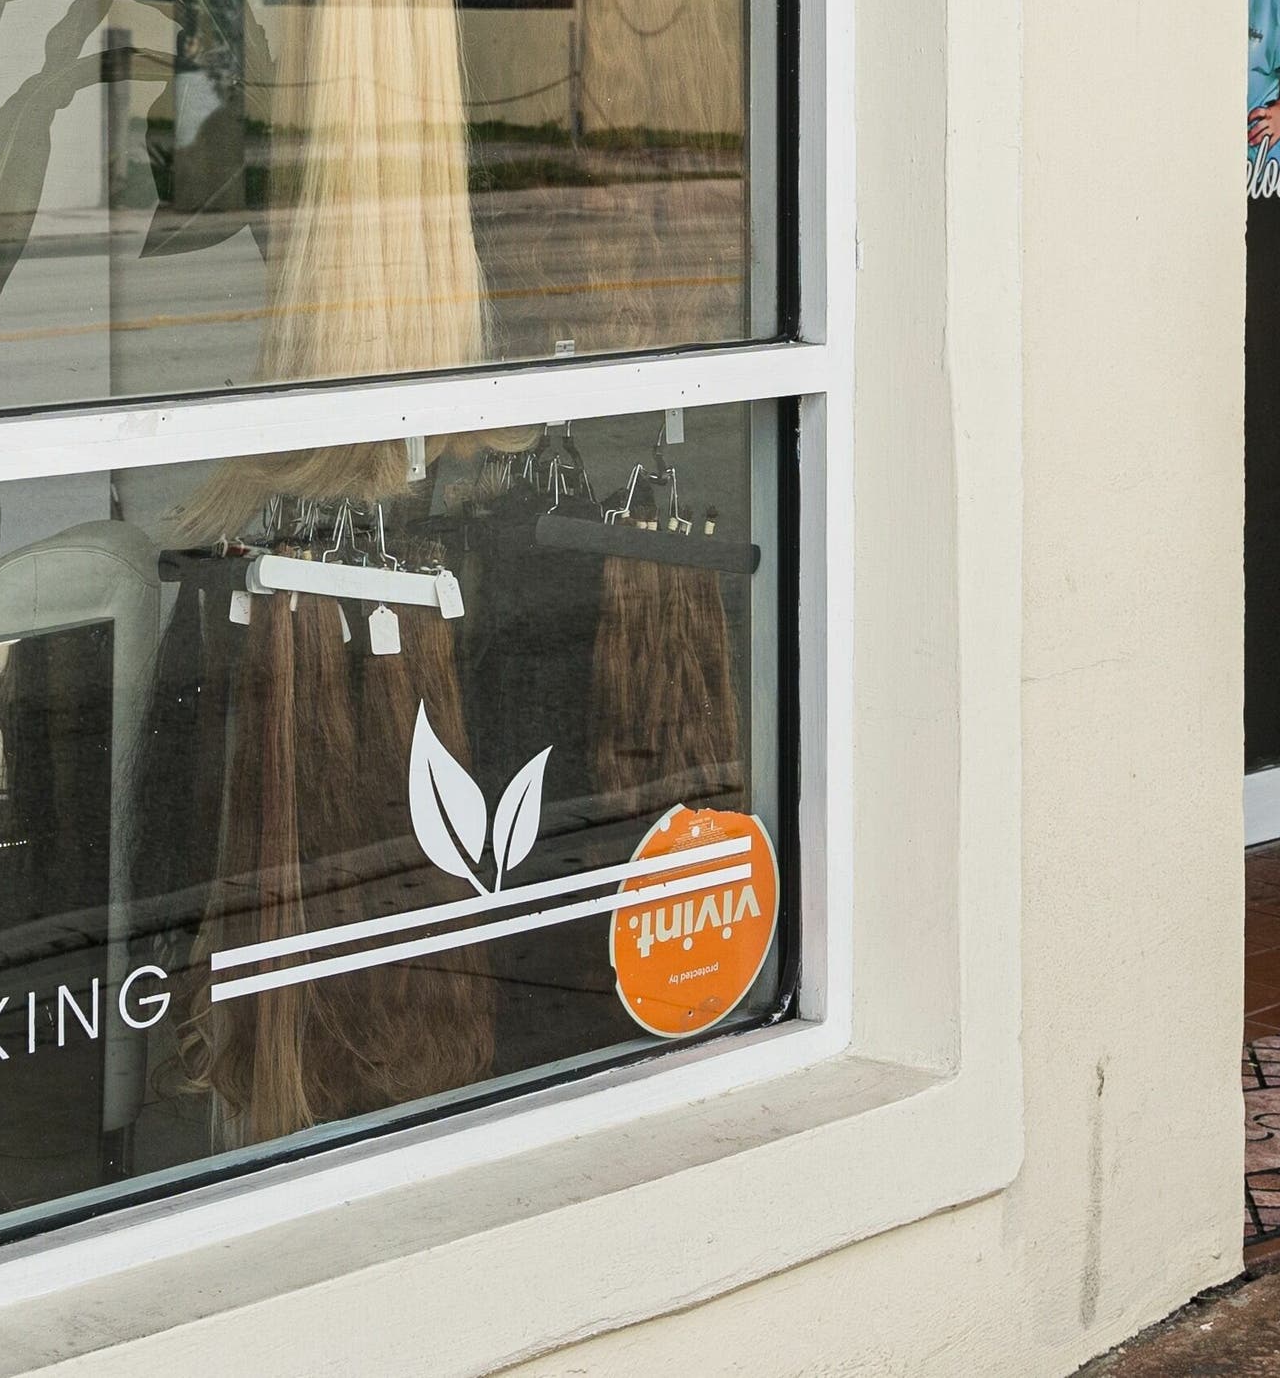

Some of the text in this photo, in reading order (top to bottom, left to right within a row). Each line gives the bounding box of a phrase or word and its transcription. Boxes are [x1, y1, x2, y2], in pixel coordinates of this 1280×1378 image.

[628, 884, 761, 959] vivint.
[669, 961, 719, 984] protected by
